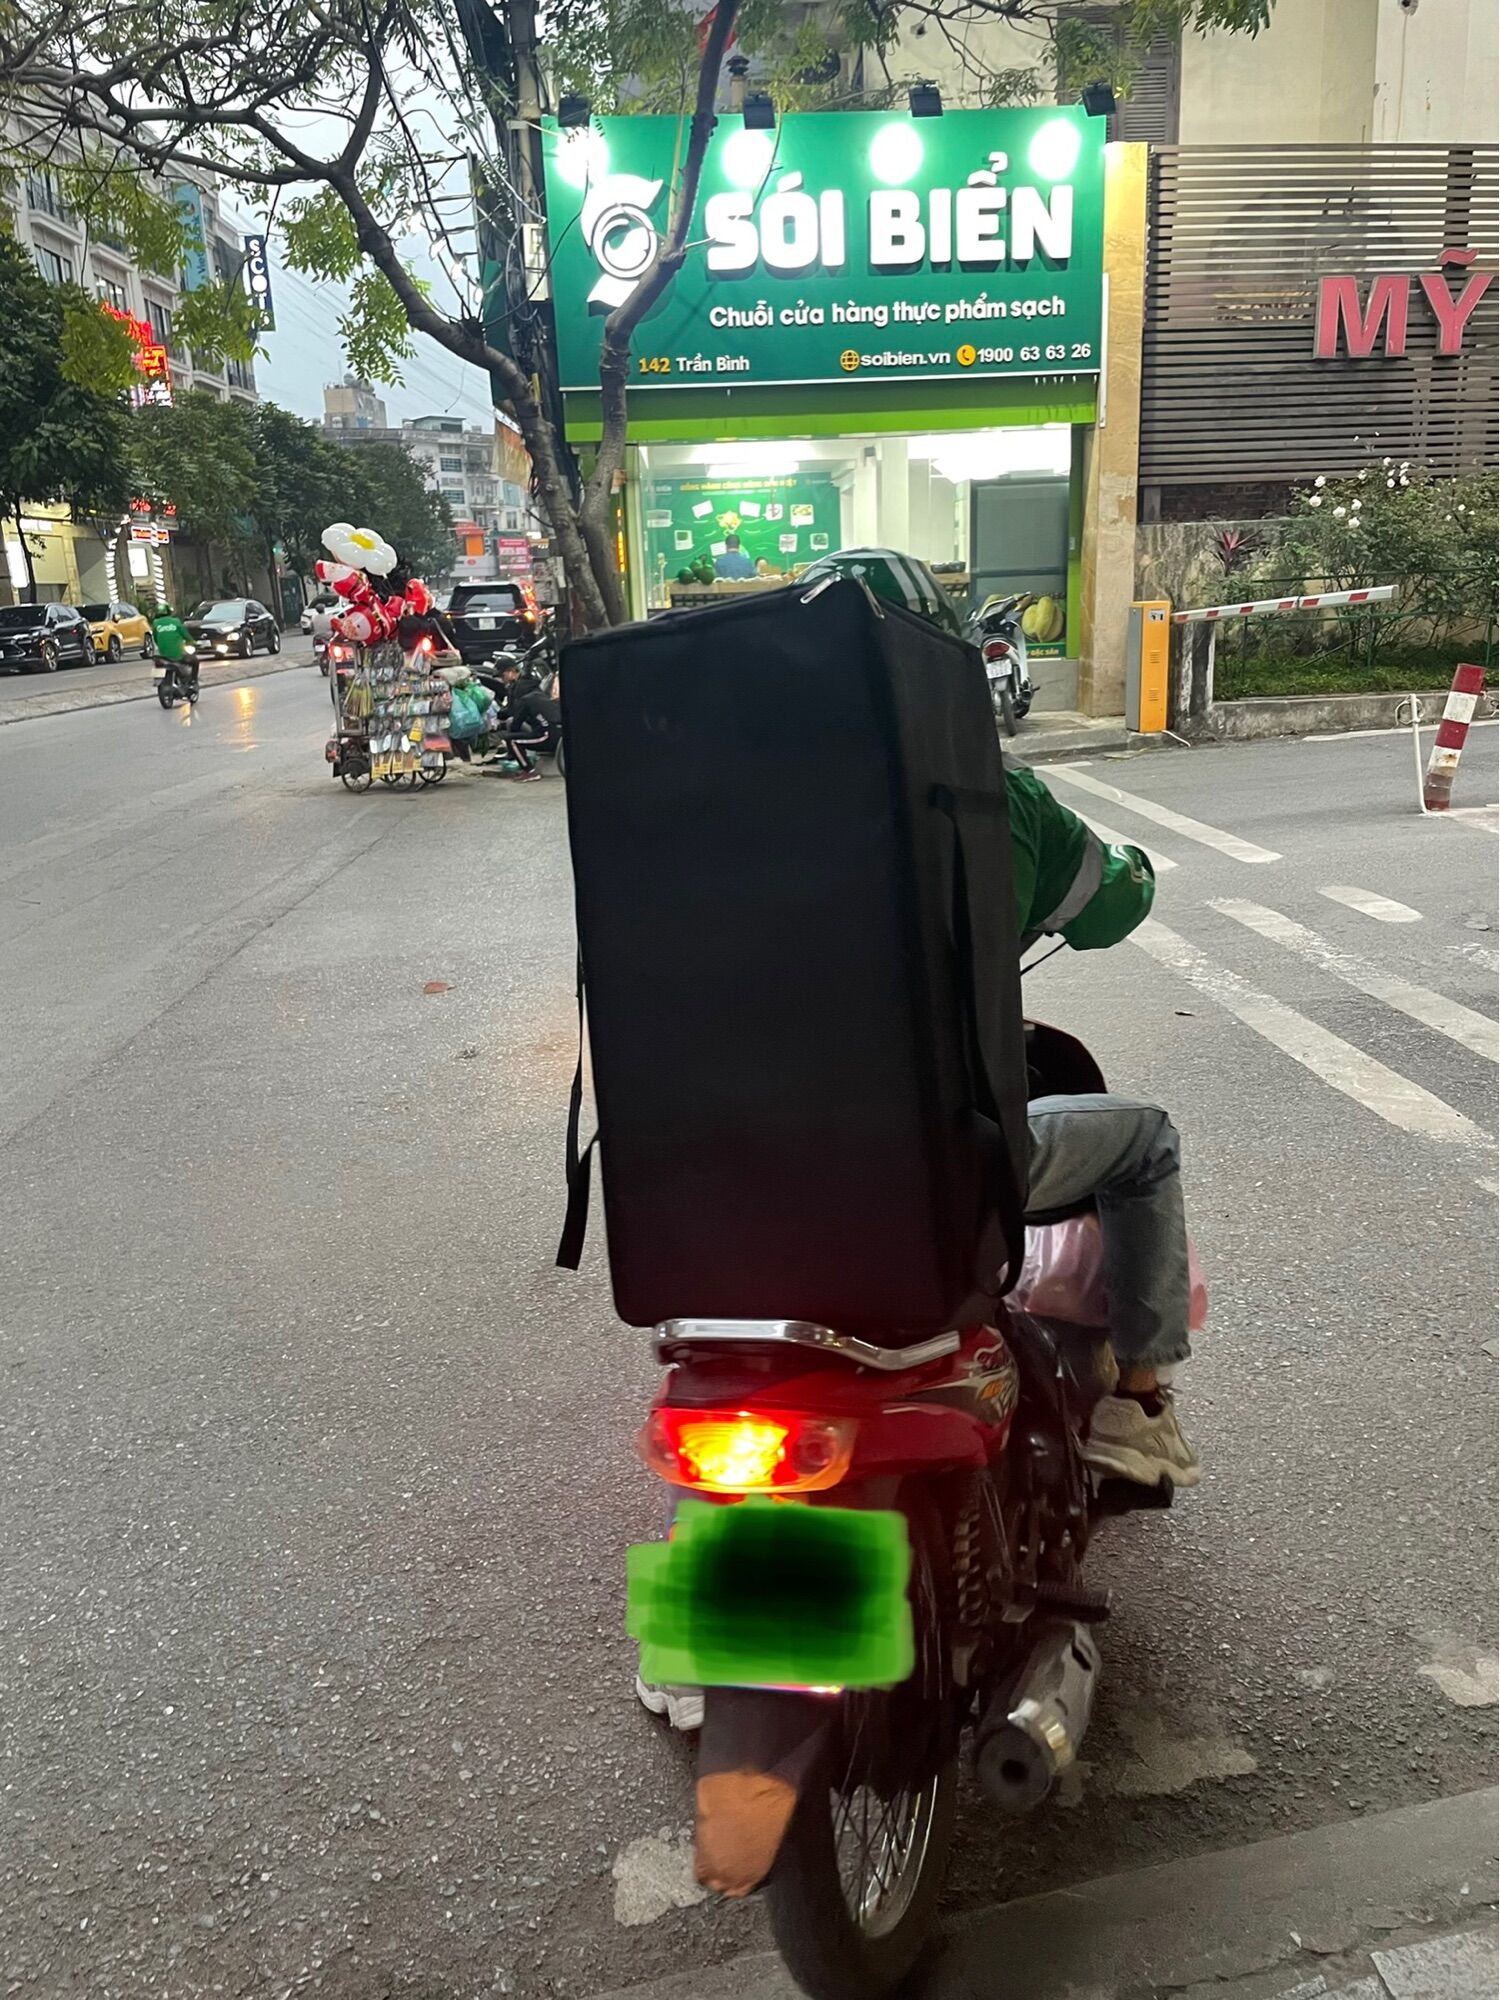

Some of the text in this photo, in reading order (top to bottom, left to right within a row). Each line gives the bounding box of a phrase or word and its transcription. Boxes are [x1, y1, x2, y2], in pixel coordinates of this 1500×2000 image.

[705, 152, 1073, 270] SÓI BIỂN
[709, 292, 1065, 328] Chuỗi cửa hàng thực phẩm sạch
[1313, 247, 1495, 359] MỸ
[639, 352, 750, 373] 142 Trần Bình
[861, 351, 951, 367] soibien.vn
[977, 343, 1091, 363] 1900 63 63 26
